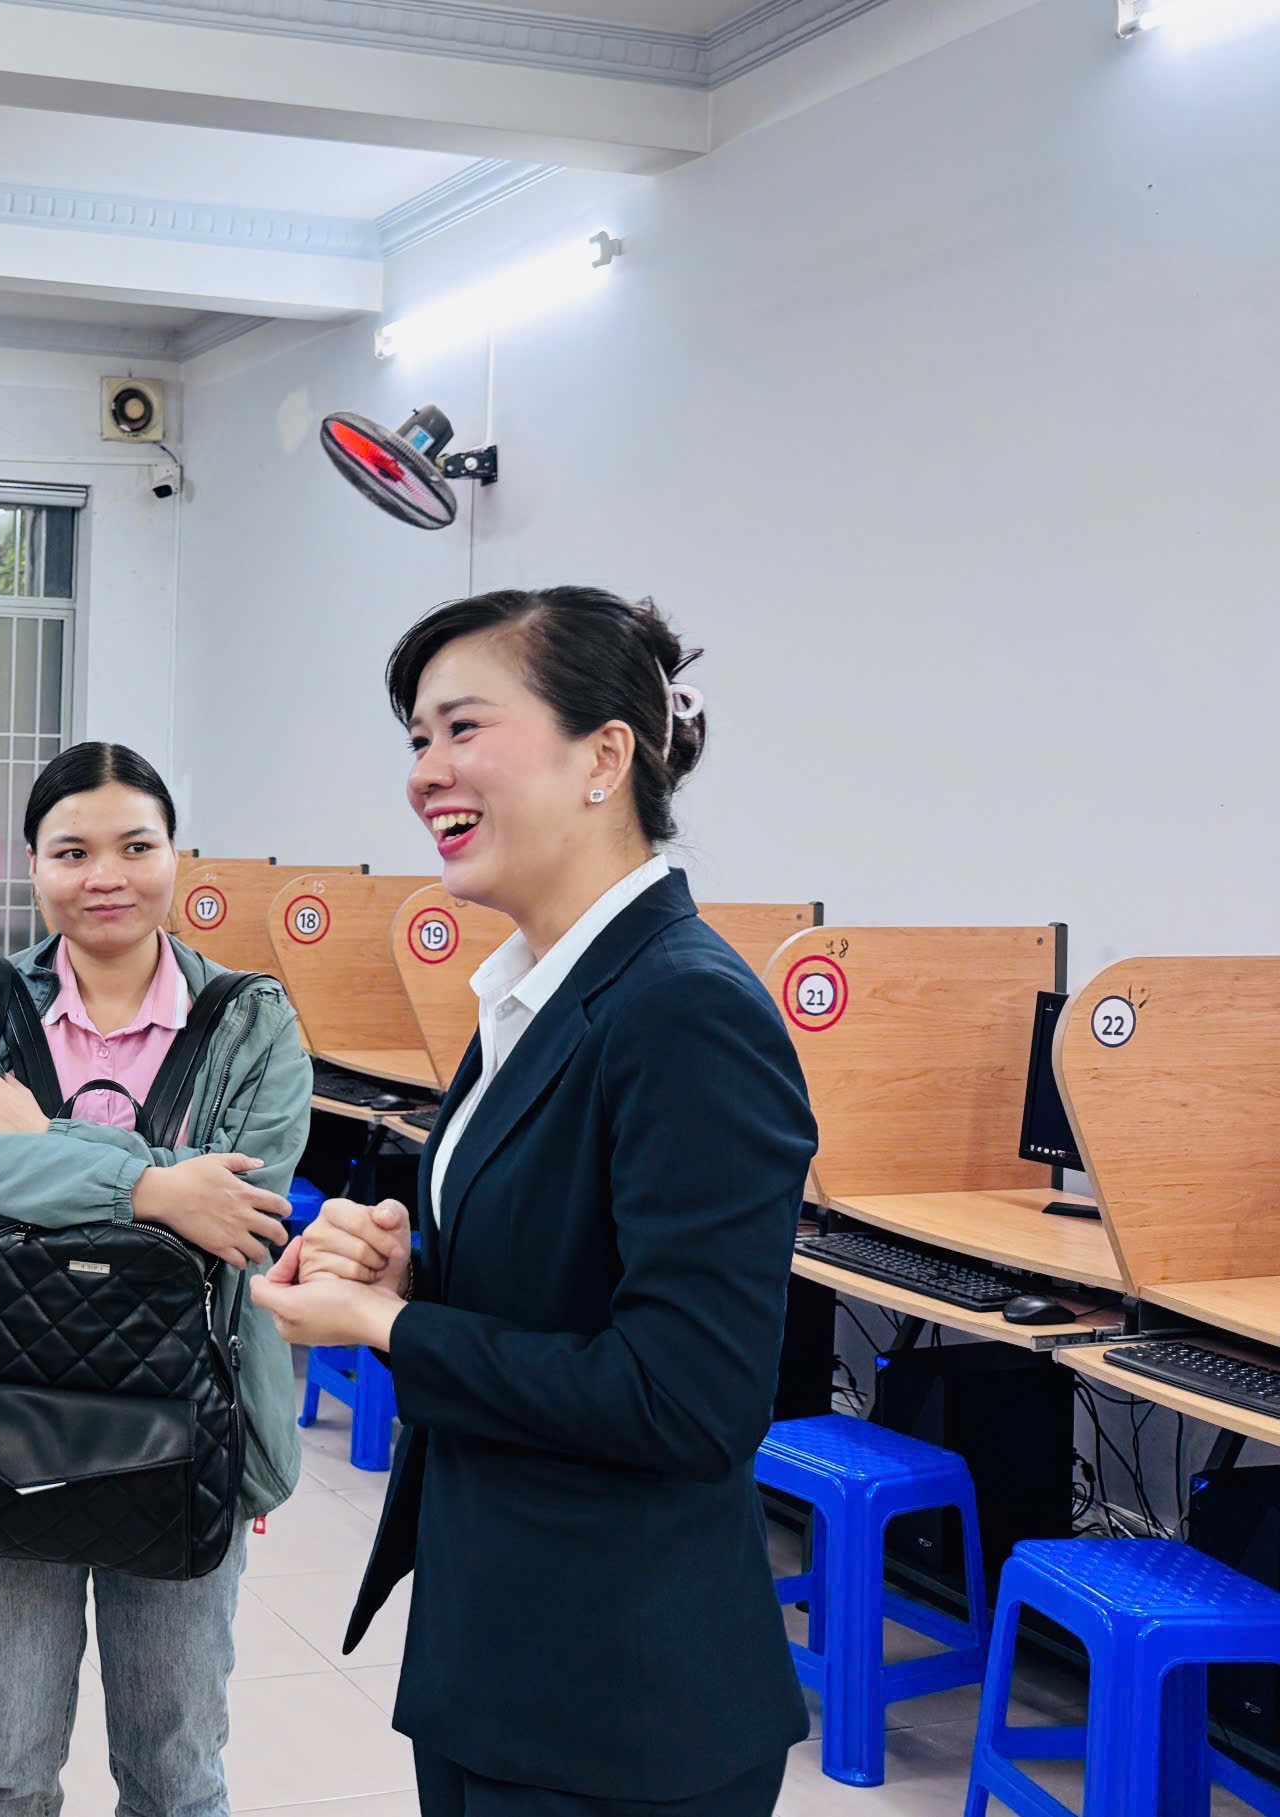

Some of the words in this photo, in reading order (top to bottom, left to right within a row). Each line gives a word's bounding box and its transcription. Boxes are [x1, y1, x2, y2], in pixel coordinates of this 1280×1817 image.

[199, 901, 214, 915] 17
[299, 913, 316, 929] 18
[424, 926, 444, 945] 19
[806, 989, 826, 1006] 21
[1102, 1015, 1125, 1036] 22
